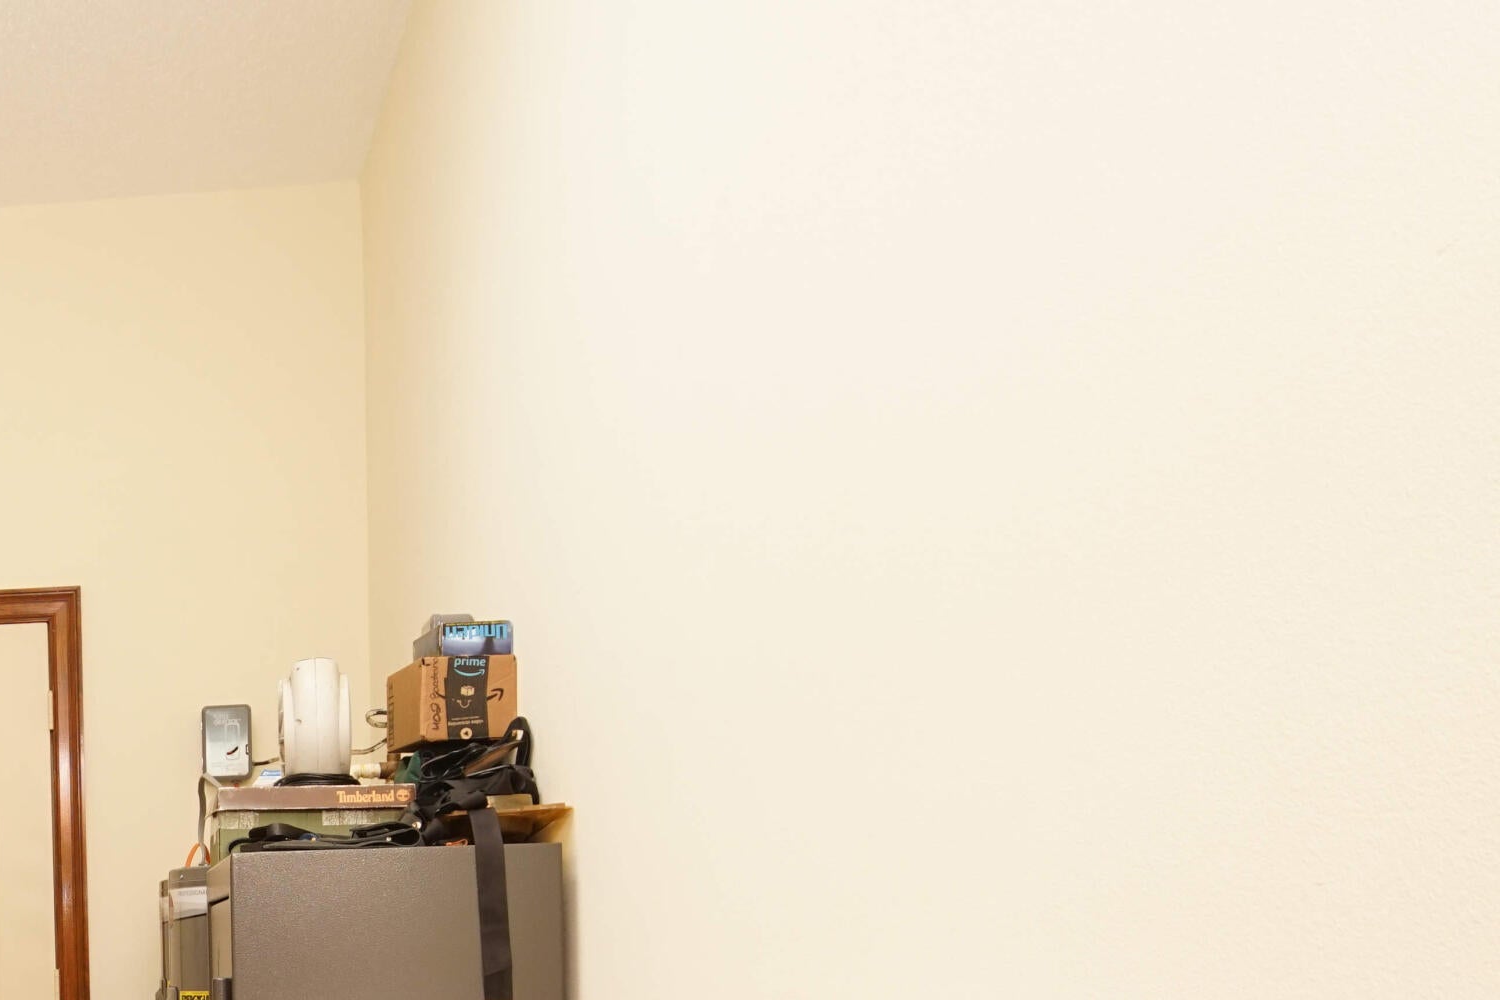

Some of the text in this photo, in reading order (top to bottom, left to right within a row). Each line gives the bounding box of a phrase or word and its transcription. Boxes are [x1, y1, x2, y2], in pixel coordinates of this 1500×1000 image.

[444, 624, 509, 641] Uniden
[454, 658, 486, 668] prime
[336, 789, 395, 803] Timberland
